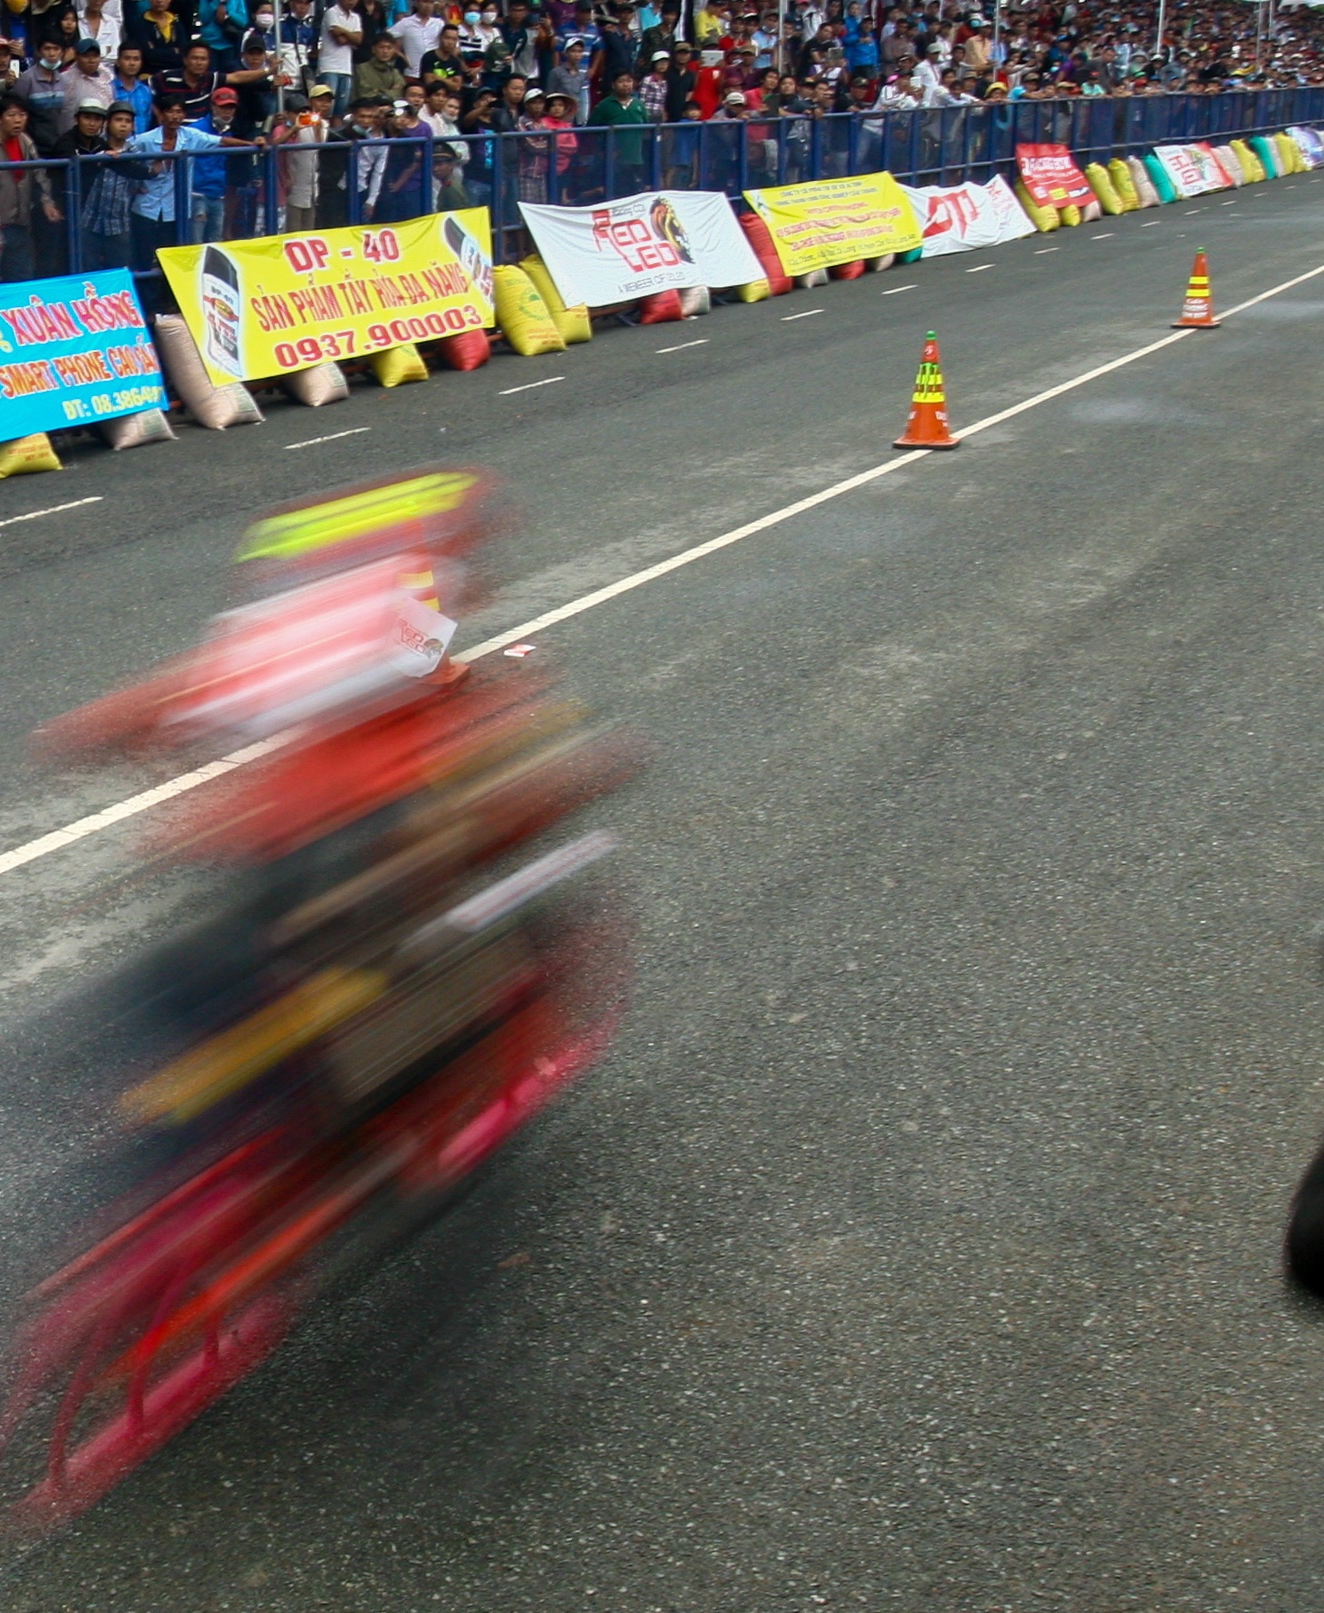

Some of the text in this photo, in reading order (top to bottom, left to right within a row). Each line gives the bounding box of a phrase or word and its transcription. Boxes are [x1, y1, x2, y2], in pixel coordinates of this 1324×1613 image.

[363, 229, 399, 263] 40
[70, 281, 146, 334] HỒNG
[275, 304, 482, 368] 0937.900003
[52, 350, 114, 387] PHONE
